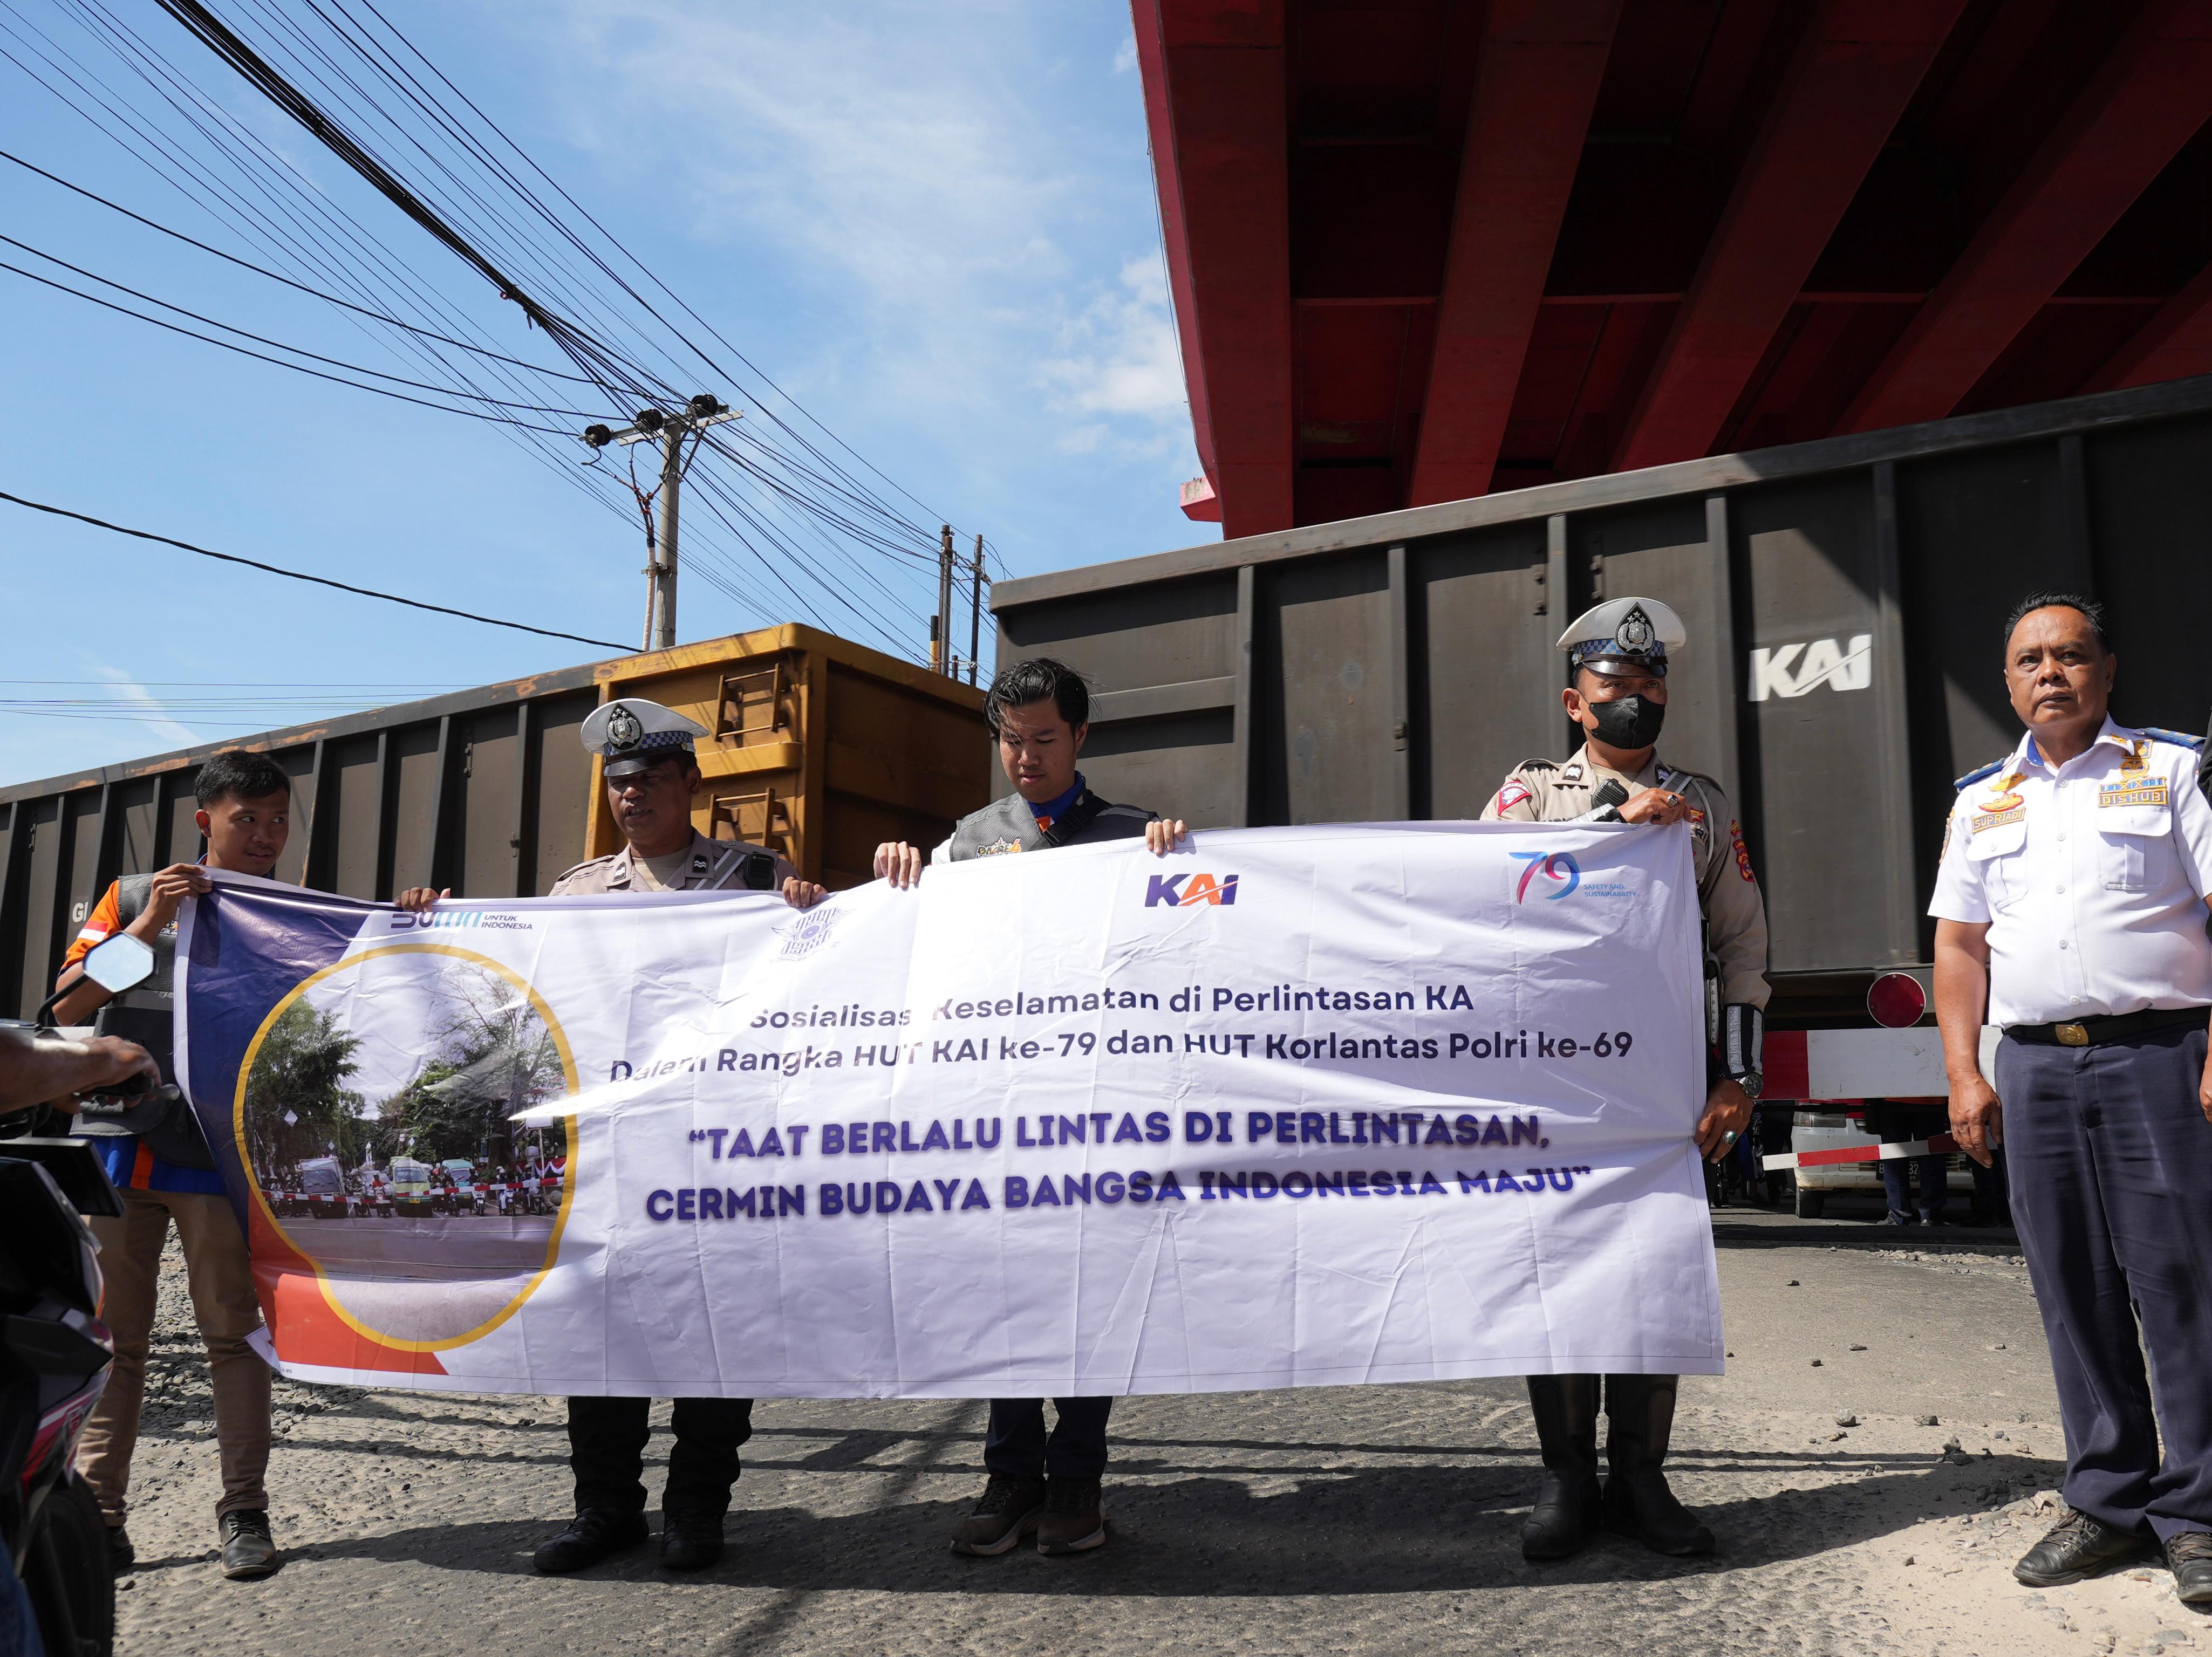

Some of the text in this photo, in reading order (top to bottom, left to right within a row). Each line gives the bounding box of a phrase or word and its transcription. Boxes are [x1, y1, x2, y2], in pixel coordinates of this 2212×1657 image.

[1749, 634, 1872, 702] KAI
[2103, 791, 2161, 804] DISHUB
[1975, 811, 2022, 829] SUPRIADI
[1144, 873, 1239, 907] KAI
[1508, 851, 1580, 905] 79
[481, 921, 532, 930] INDONESIA
[932, 987, 1159, 1021] Keselamatan
[1169, 985, 1201, 1012] di
[1213, 984, 1415, 1012] Perlintasan
[1426, 985, 1474, 1011] KA
[717, 1046, 843, 1077] Rangka
[854, 1042, 923, 1067] HUT
[932, 1038, 988, 1063] KAI
[1000, 1032, 1097, 1060] ke-79
[1107, 1029, 1173, 1055] dan
[1184, 1033, 1255, 1058] HUT
[1266, 1031, 1438, 1060] Korlantas
[1450, 1030, 1527, 1059] Polri
[1538, 1031, 1633, 1059] ke-69
[689, 1111, 1549, 1159] “TAAT BERLALU LINTAS DI PERLINTASAN,
[647, 1165, 1592, 1221] CERMIN BUDAYA BANGSA INDONESIA MAJU”
